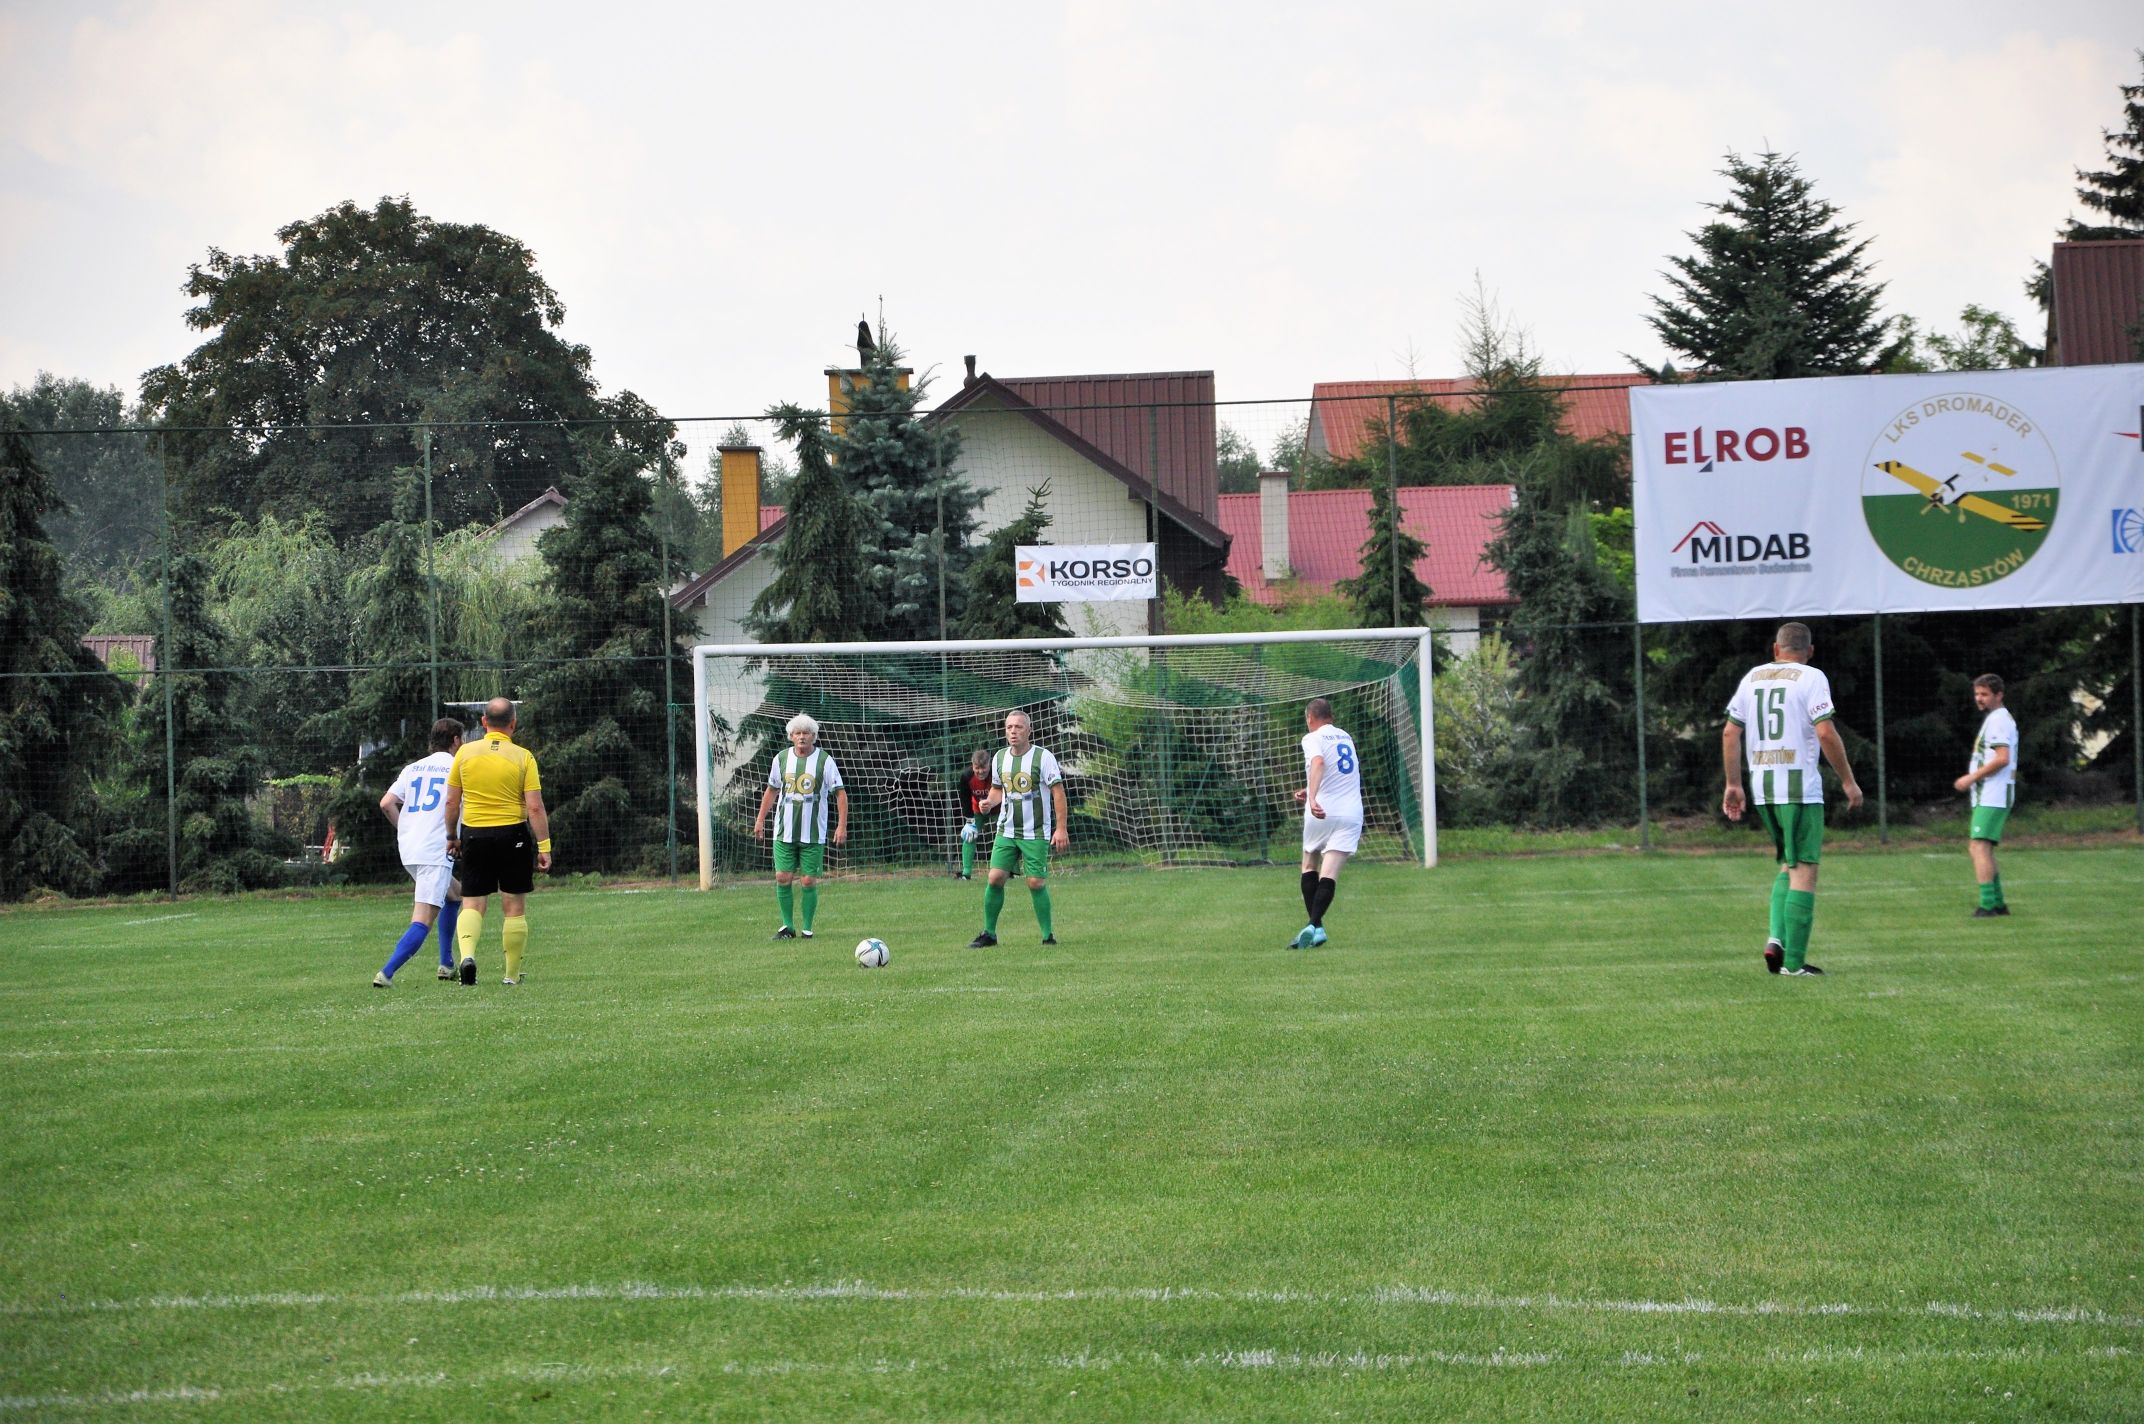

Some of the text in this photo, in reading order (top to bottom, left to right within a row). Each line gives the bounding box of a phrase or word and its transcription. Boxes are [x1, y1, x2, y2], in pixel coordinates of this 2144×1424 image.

[1885, 397, 2032, 443] LKS DROMADER
[1664, 426, 1810, 465] ELROB
[2011, 494, 2051, 509] 1971
[1691, 533, 1811, 563] MIDAB
[1050, 558, 1153, 579] KORSO
[1051, 577, 1153, 587] TYGODNIK REGIONALNY
[1903, 548, 2024, 588] CHRZĄSTÓW
[1754, 687, 1787, 741] 15
[1337, 743, 1354, 775] 8
[408, 776, 445, 813] 15
[784, 773, 815, 794] 50
[1001, 771, 1032, 793] 50
